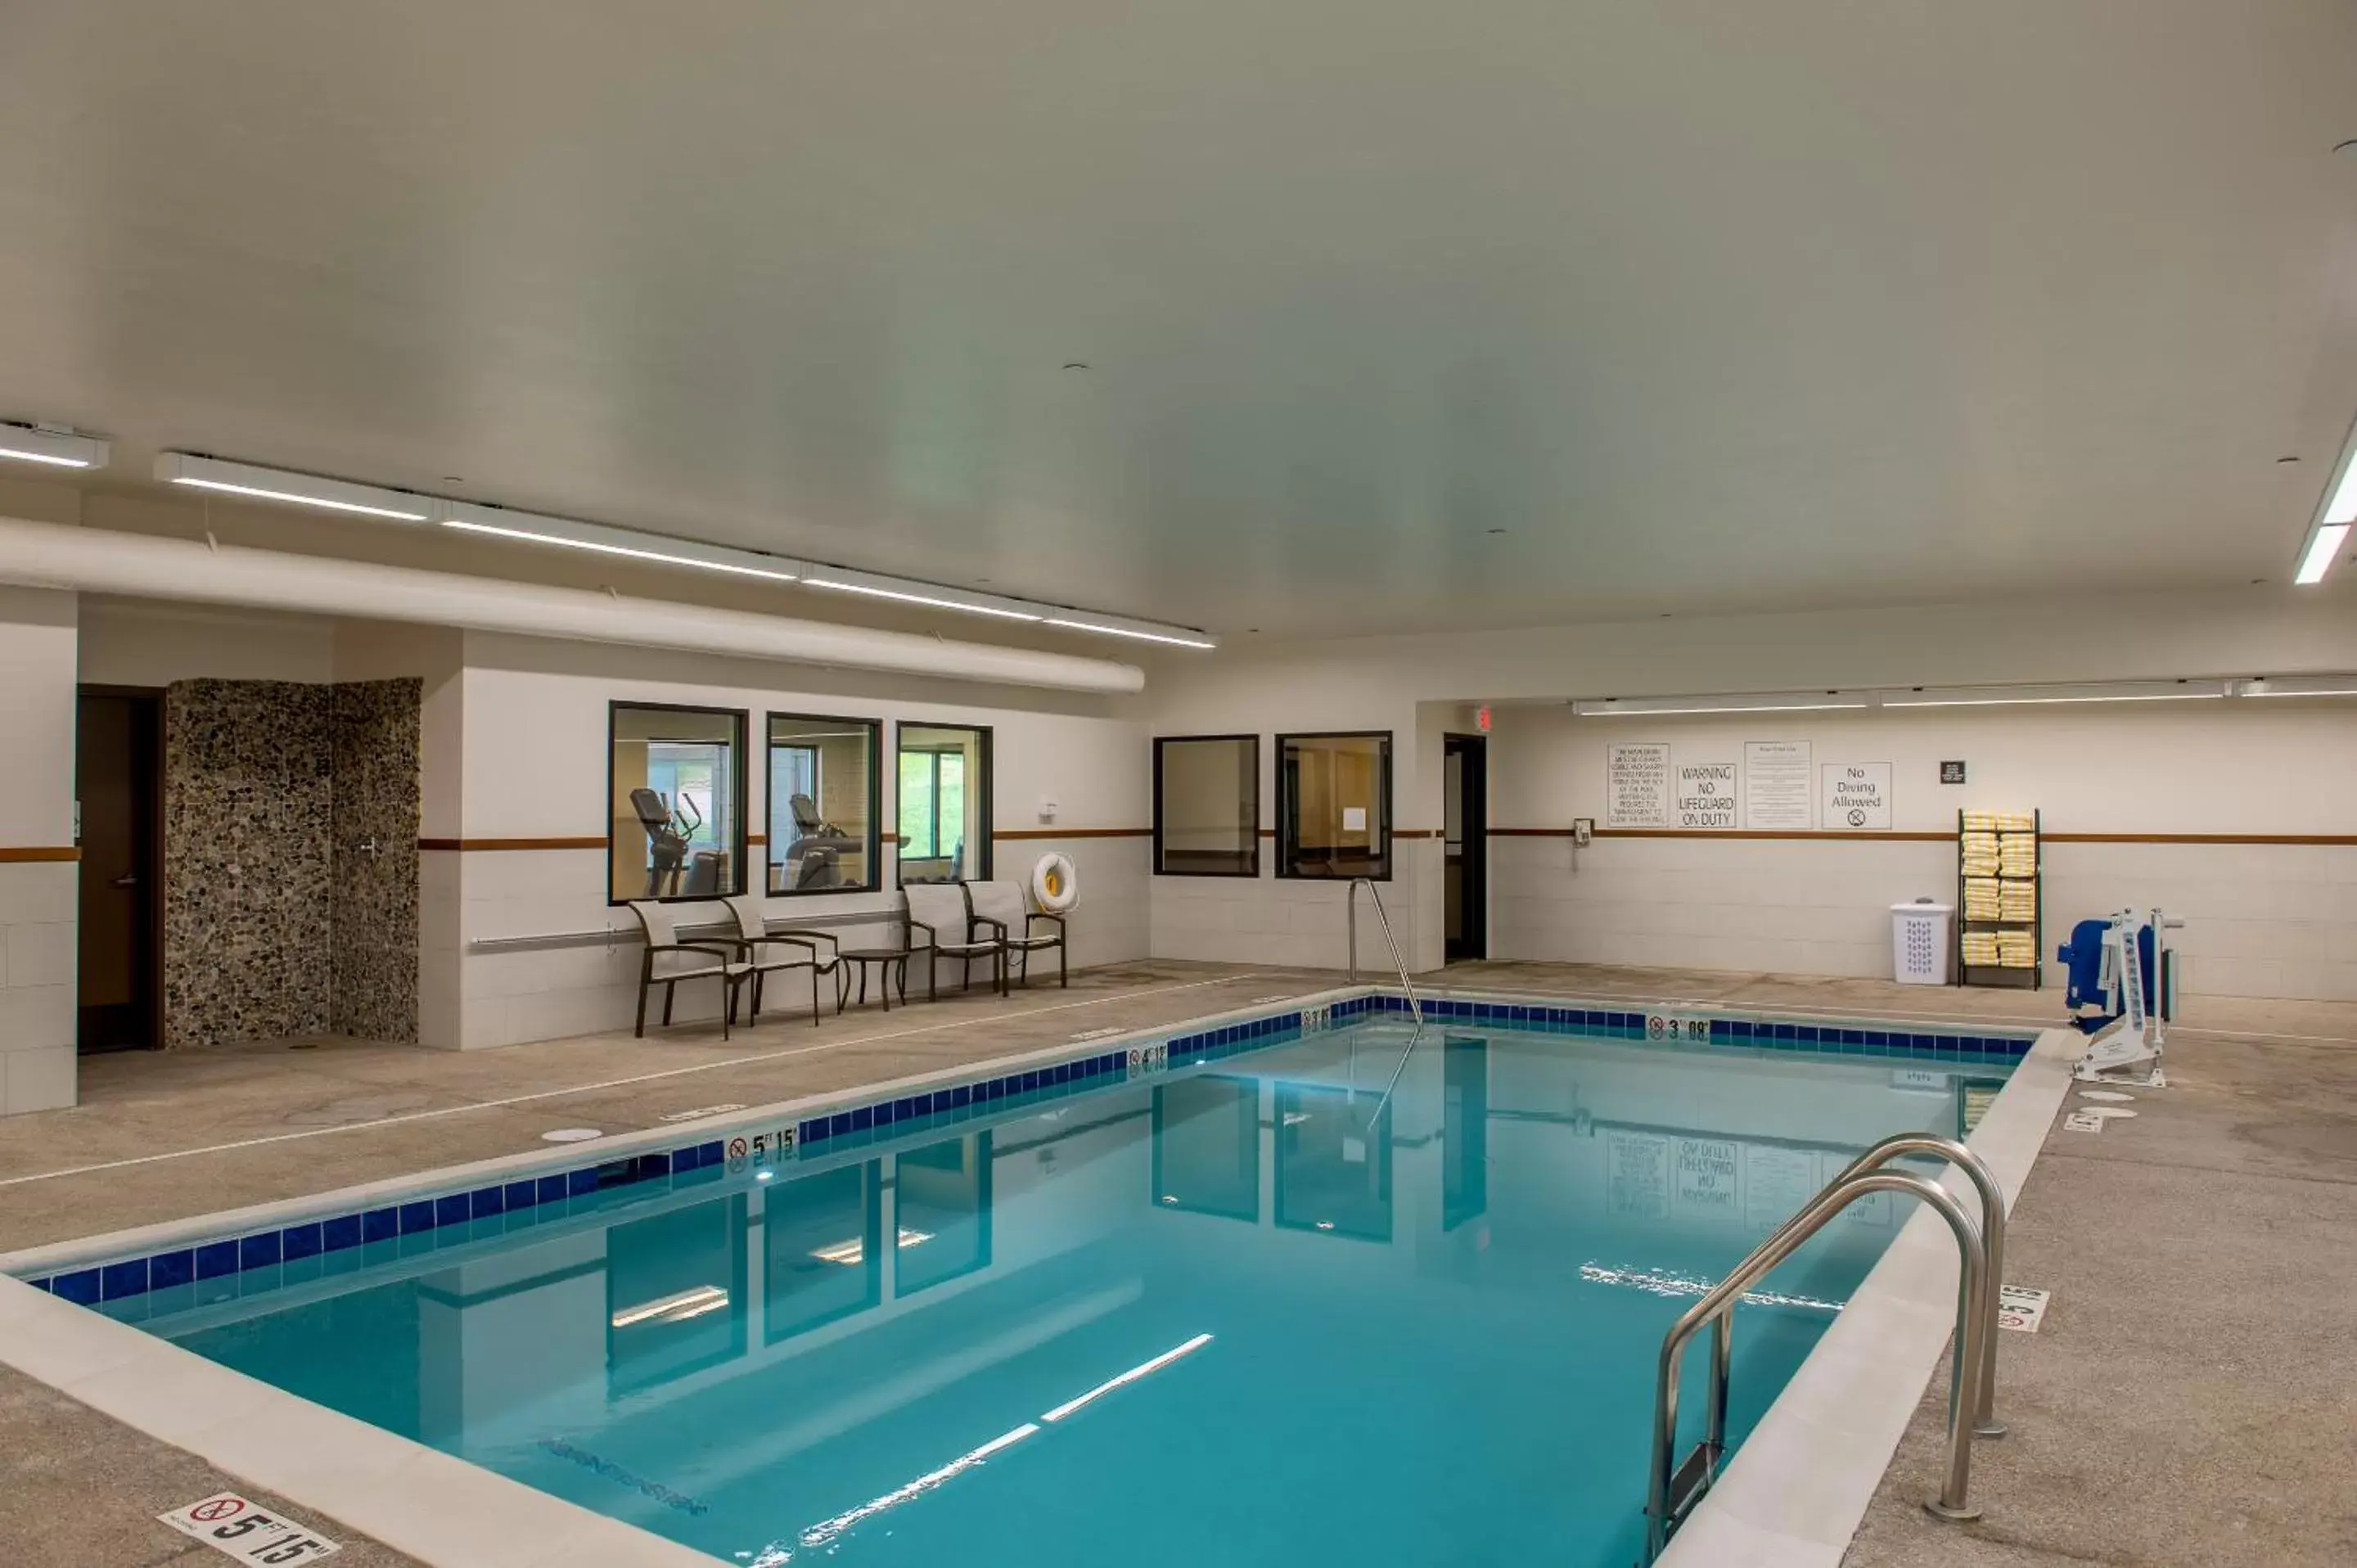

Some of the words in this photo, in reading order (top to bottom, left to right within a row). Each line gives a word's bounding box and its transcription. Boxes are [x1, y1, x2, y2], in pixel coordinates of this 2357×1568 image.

[1682, 766, 1731, 780] WARNING
[1847, 768, 1865, 778] No
[1698, 782, 1715, 795] NO
[1837, 782, 1876, 796] Diving
[1679, 797, 1734, 809] LIFEGUARD
[1832, 796, 1882, 808] Allowed
[1682, 813, 1698, 825] ON
[1701, 813, 1731, 825] DUTY
[753, 1135, 765, 1154] 5
[212, 1514, 273, 1539] 5
